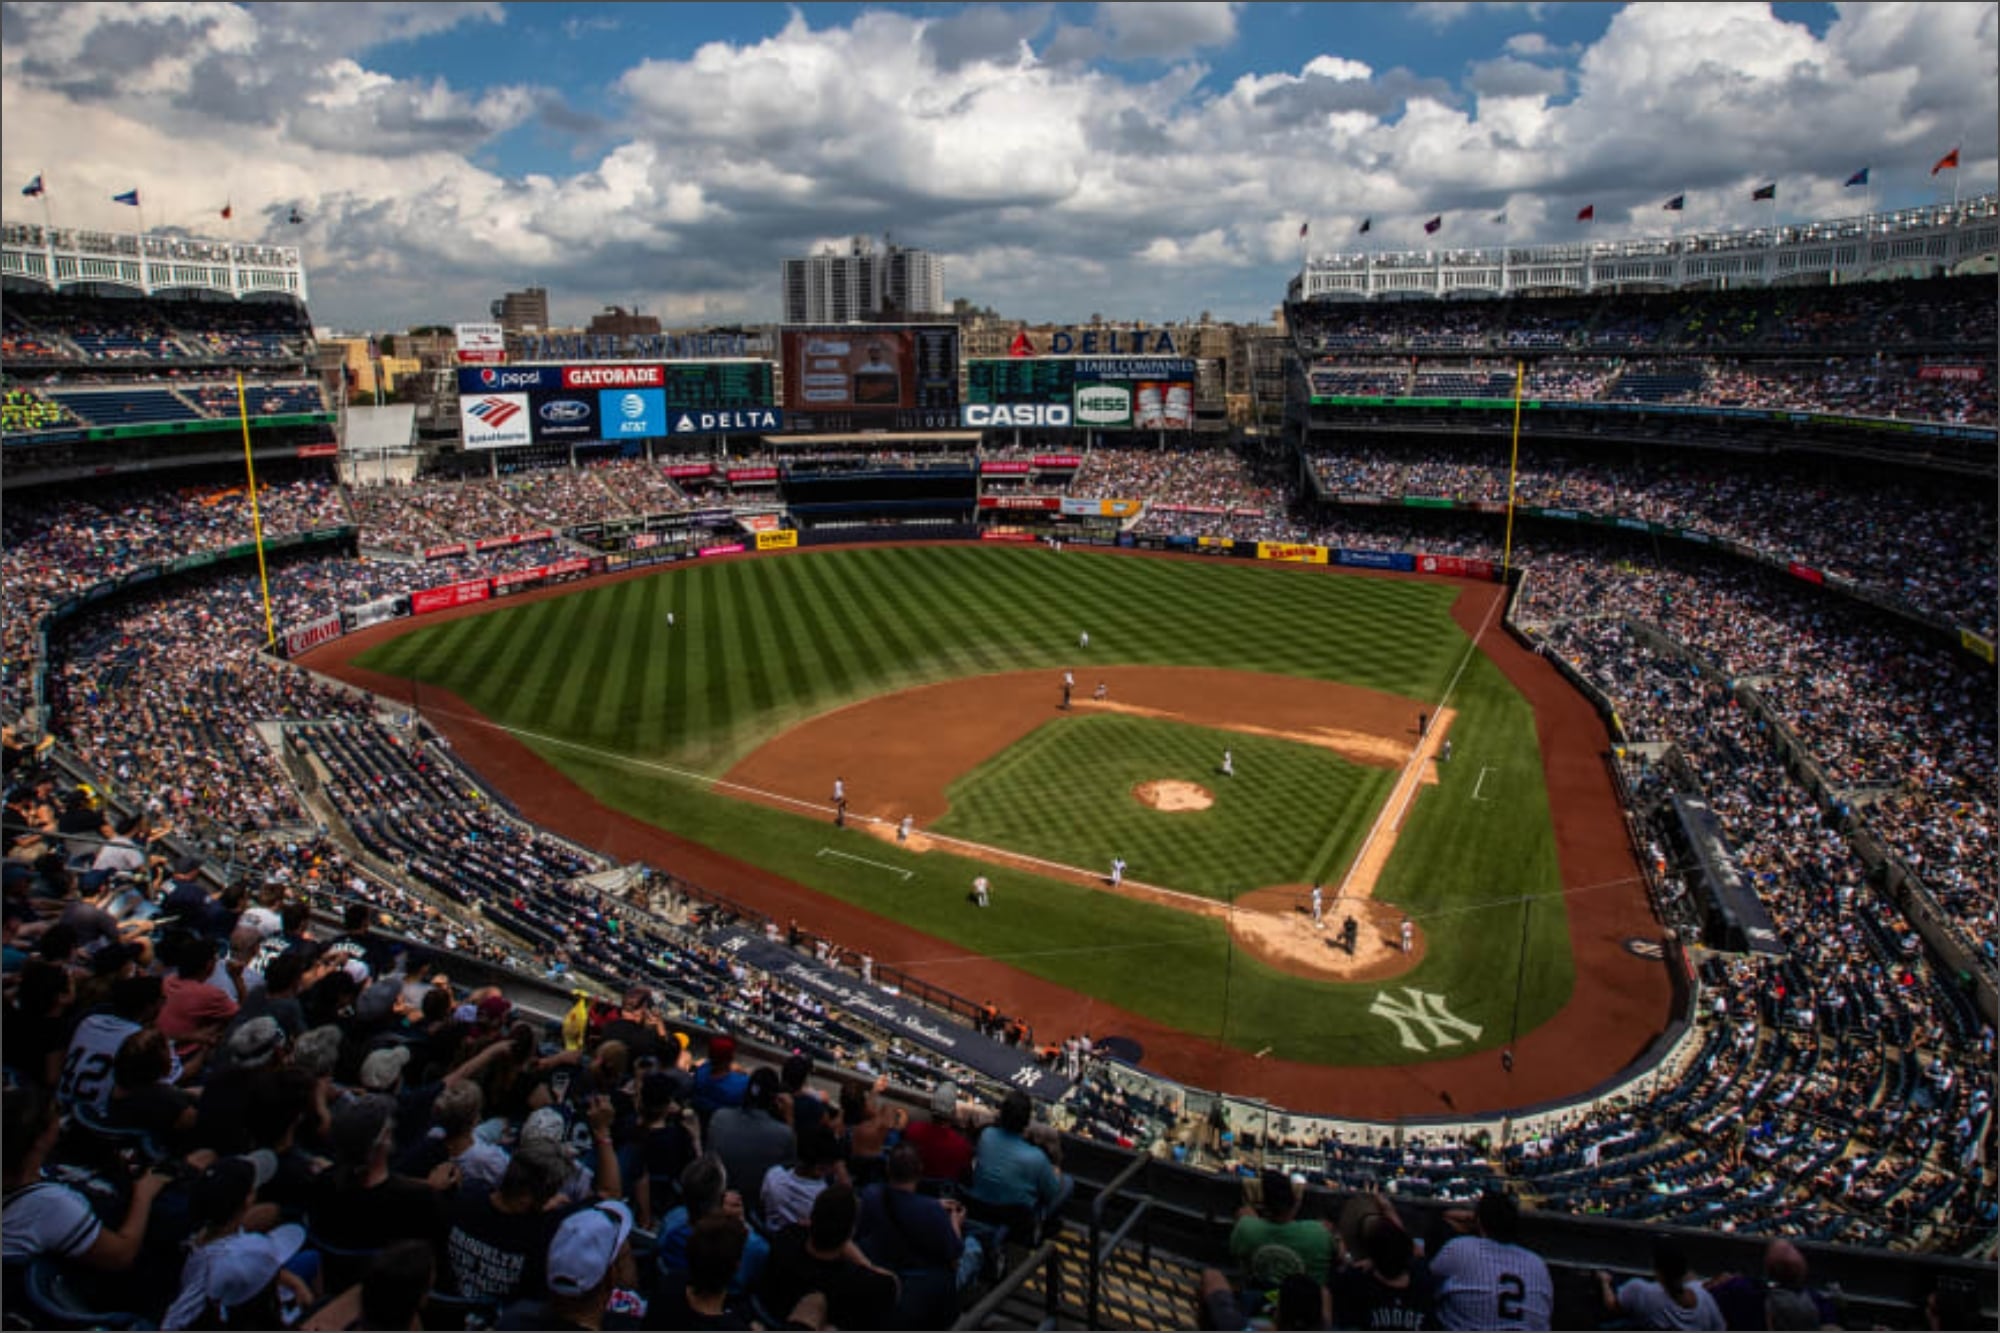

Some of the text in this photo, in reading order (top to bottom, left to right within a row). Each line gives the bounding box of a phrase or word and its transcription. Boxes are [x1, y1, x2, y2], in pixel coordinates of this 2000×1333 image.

[520, 334, 747, 360] YANKEE STADIUM
[1053, 332, 1177, 354] DELTA
[502, 371, 541, 387] pepsi
[568, 368, 658, 384] GATORADE
[966, 404, 1070, 426] CASIO
[1080, 397, 1128, 411] HESS
[619, 421, 647, 433] AT&T
[701, 412, 776, 429] DELTA
[288, 616, 341, 654] Canon
[1368, 986, 1482, 1052] NY
[1498, 1273, 1524, 1319] 2
